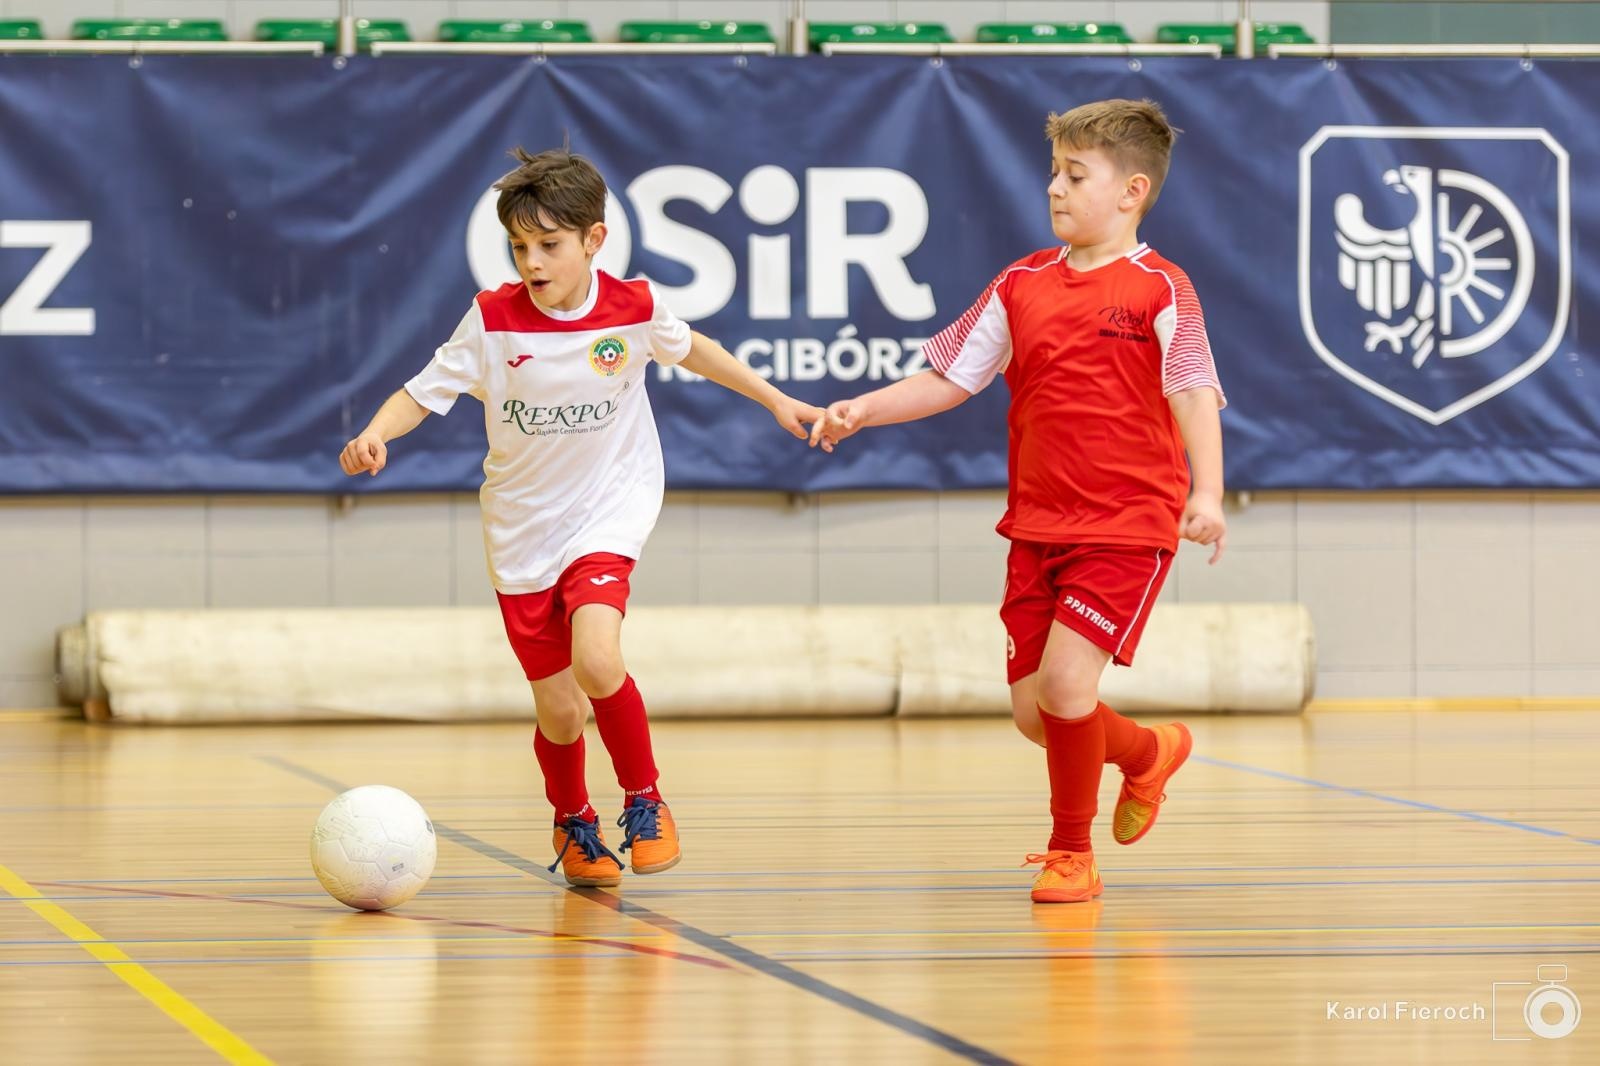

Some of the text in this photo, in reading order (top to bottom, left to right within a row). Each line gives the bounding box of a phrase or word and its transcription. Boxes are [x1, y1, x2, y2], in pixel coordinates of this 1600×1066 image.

[466, 165, 936, 322] OSiR
[0, 220, 96, 336] Z
[657, 323, 933, 382] CIBÓRZ
[560, 427, 588, 435] Centrum
[1070, 599, 1118, 636] PATRICK
